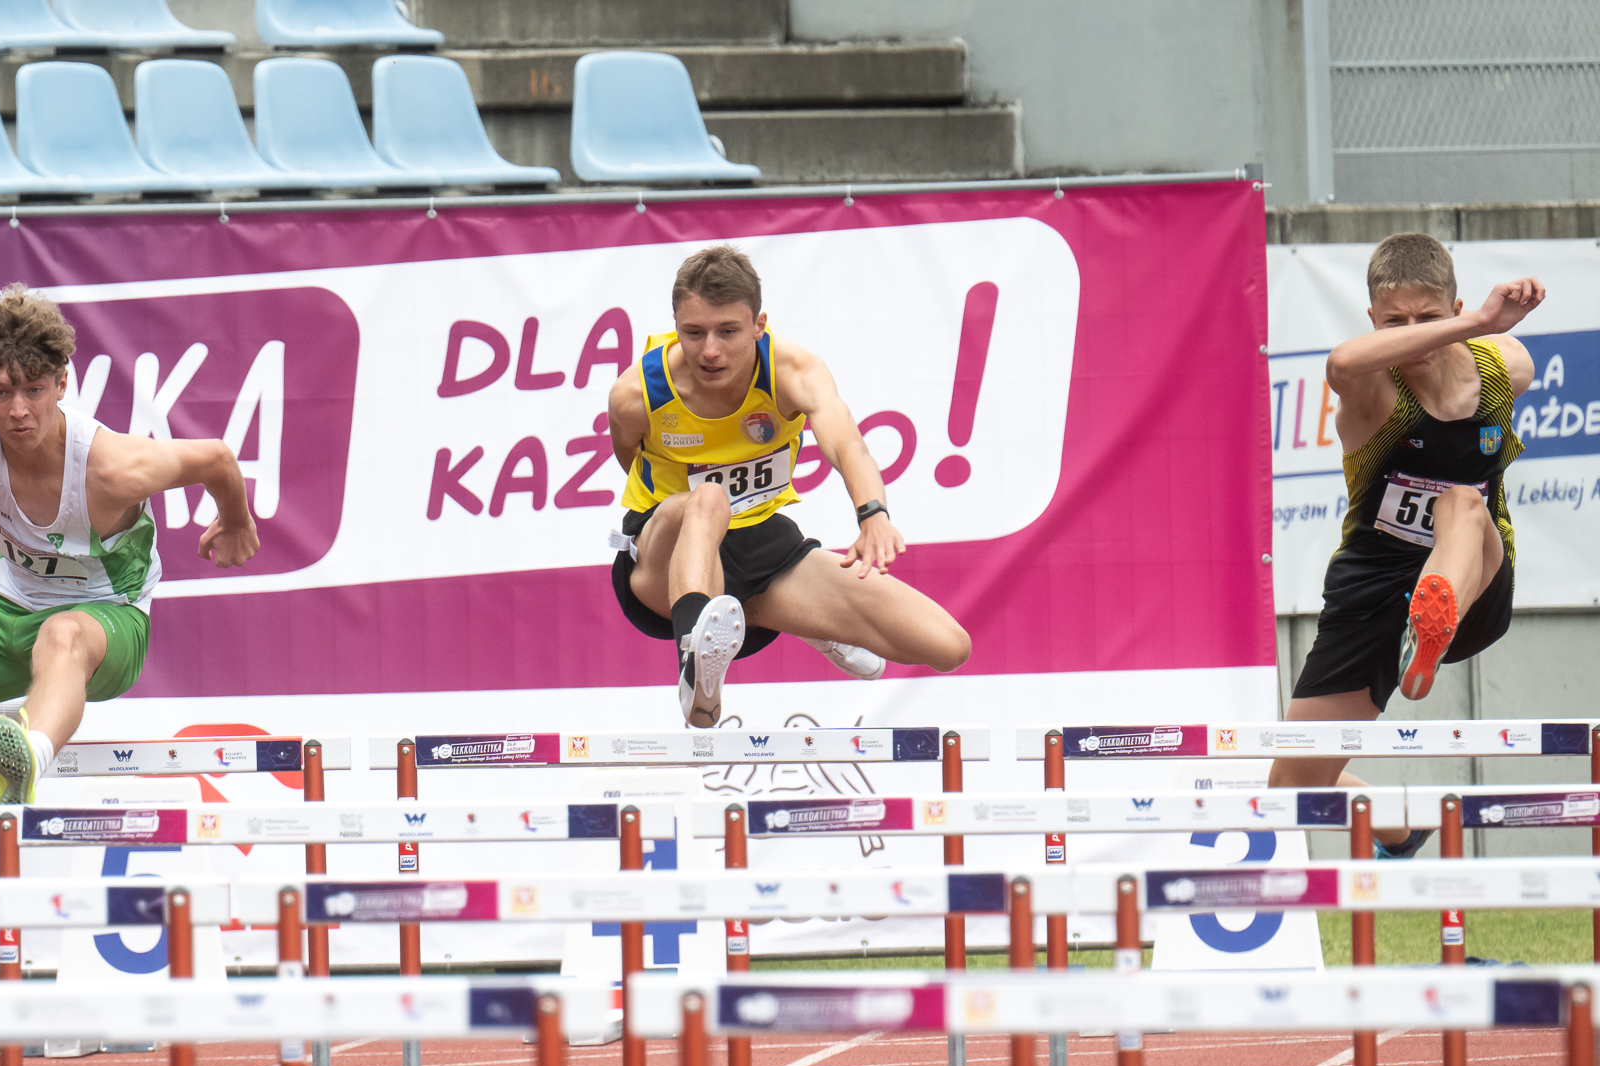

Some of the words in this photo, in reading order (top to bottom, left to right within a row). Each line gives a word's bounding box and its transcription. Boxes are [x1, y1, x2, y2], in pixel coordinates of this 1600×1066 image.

[437, 307, 633, 398] DLA
[1518, 477, 1584, 511] Lekkiej
[1273, 503, 1327, 530] ogram
[1396, 490, 1434, 531] 59
[3, 540, 58, 575] 127
[452, 743, 502, 755] LEKKOATLETYKA
[1100, 735, 1150, 748] LEKKOATLETYKA
[64, 819, 121, 832] LEKKOATLETYKA
[790, 808, 848, 823] LEKKOATLETYKA
[1189, 830, 1285, 954] 3
